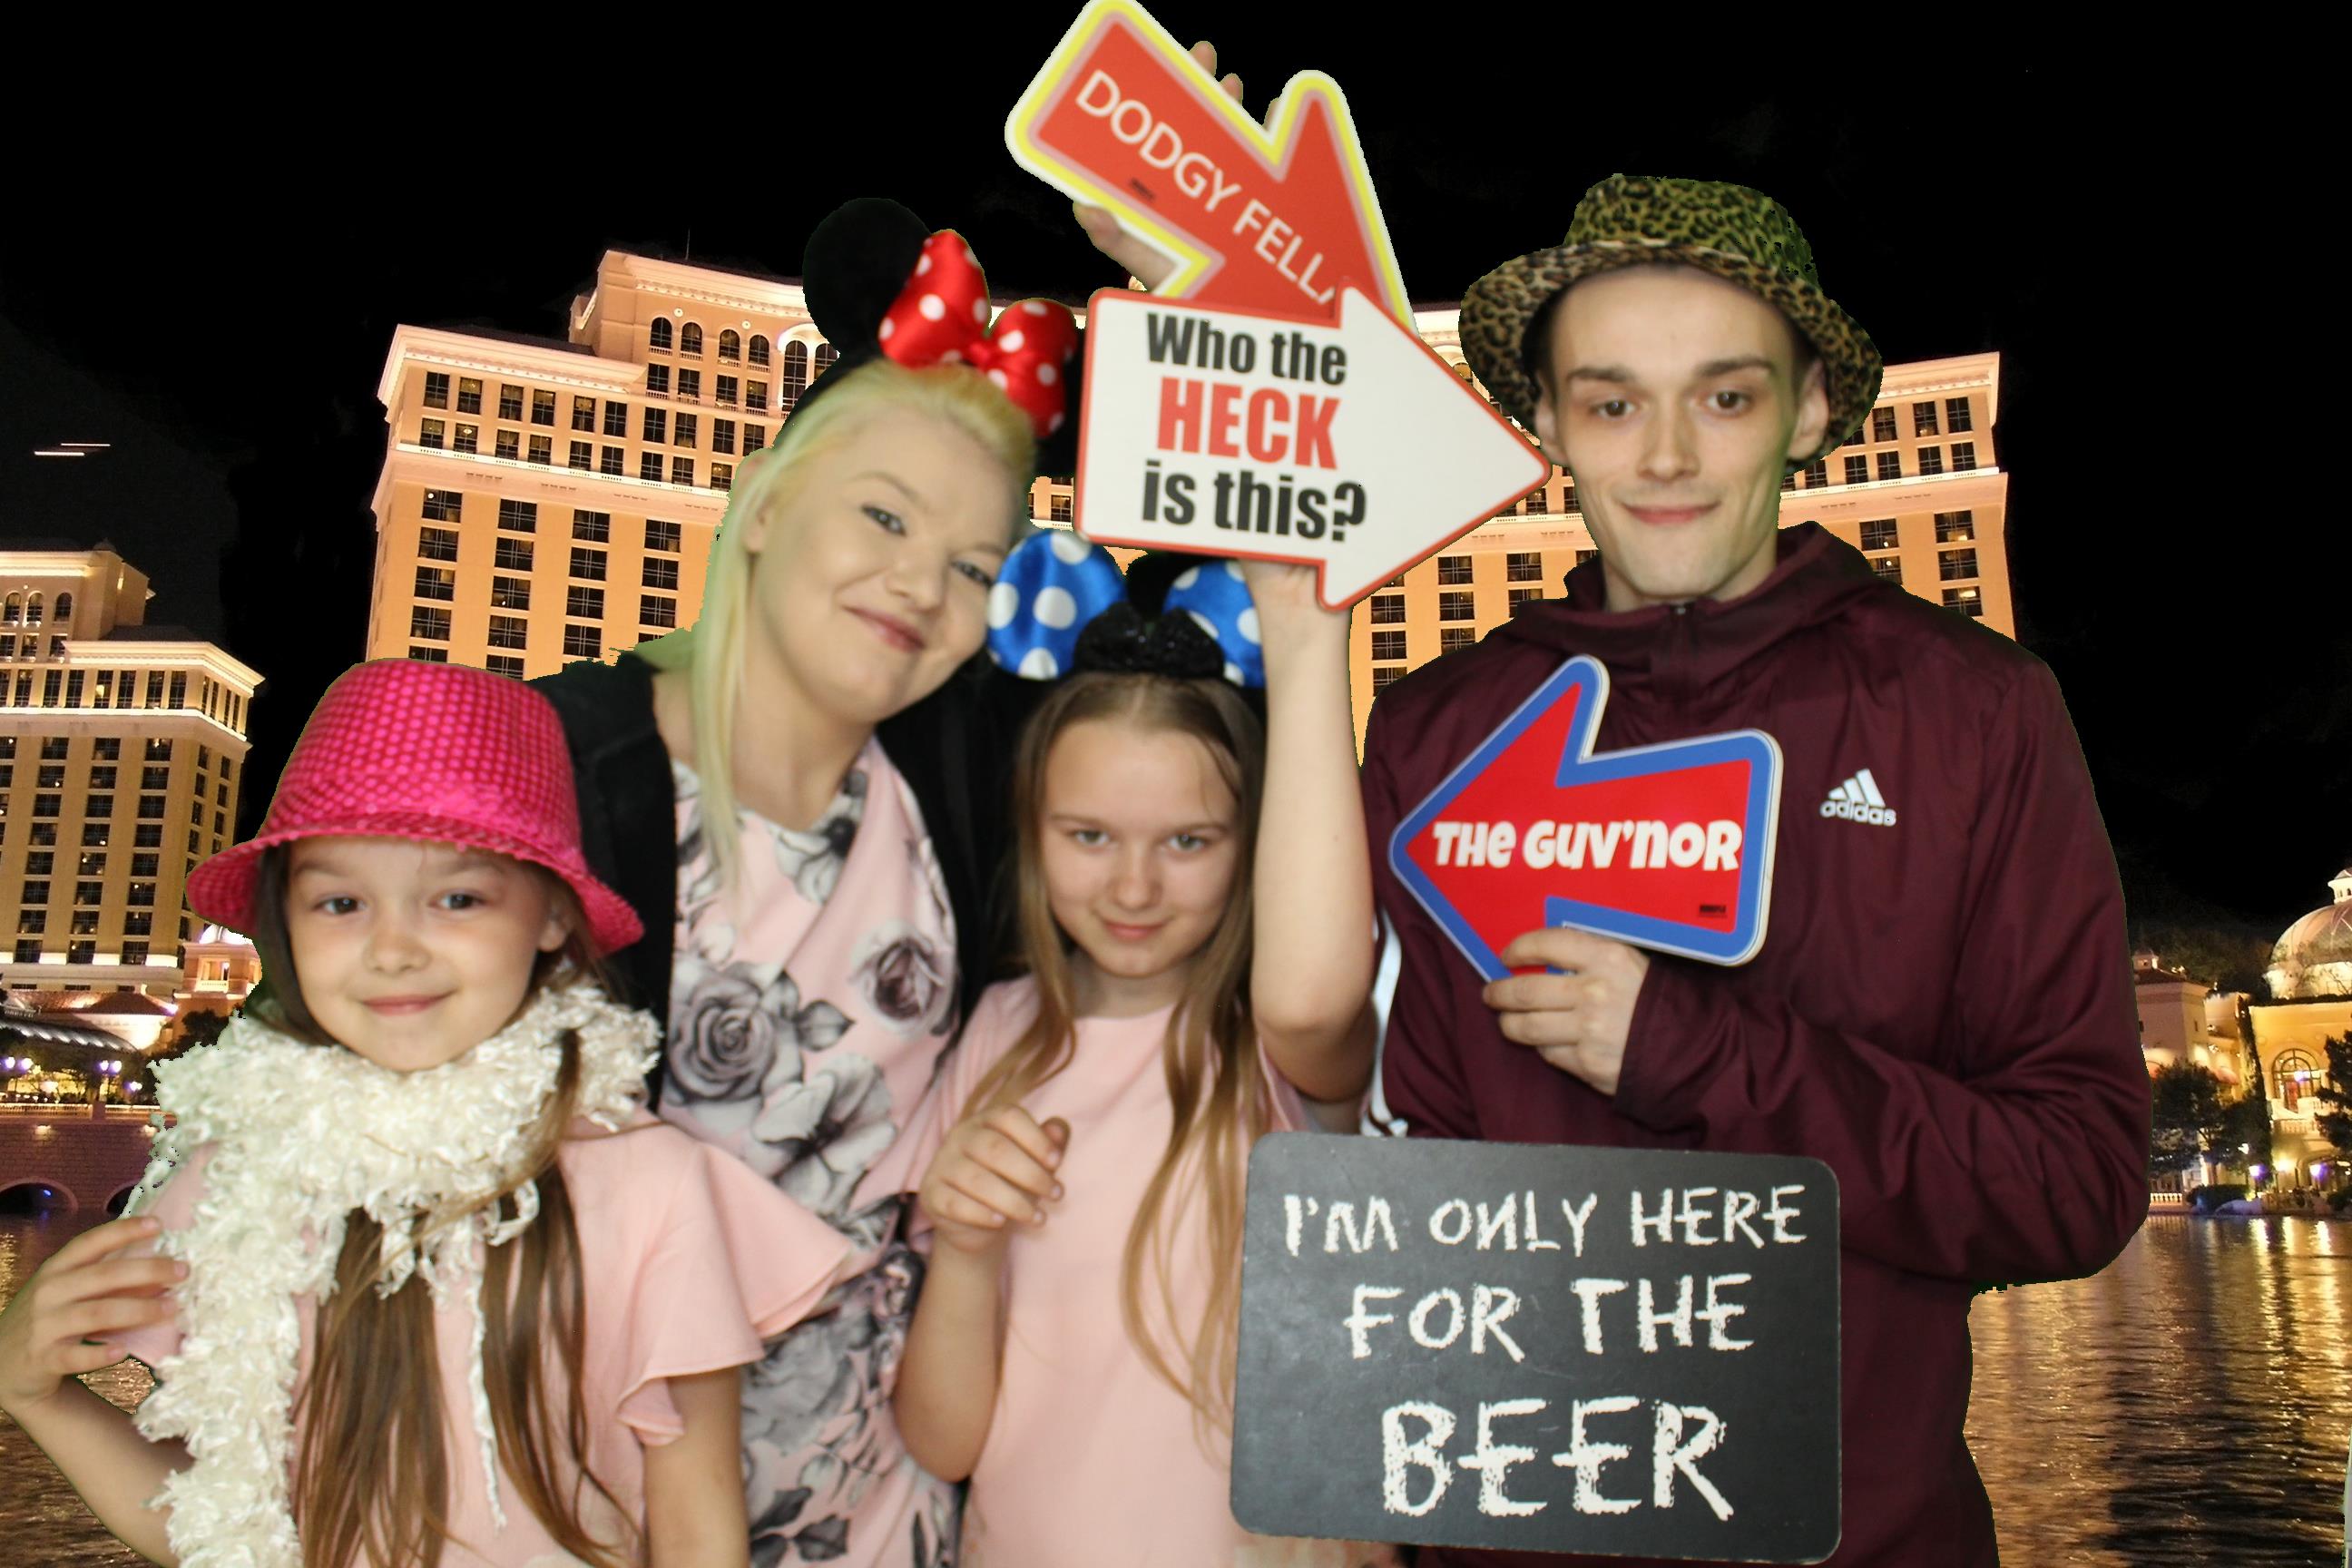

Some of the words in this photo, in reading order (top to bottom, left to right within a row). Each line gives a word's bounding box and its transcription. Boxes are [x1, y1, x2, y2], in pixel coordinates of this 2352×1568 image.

[1075, 70, 1241, 212] DODGY
[1146, 313, 1256, 375] Who
[1270, 332, 1348, 386] the
[1156, 377, 1340, 470] HECK
[1141, 459, 1196, 525] is
[1213, 470, 1367, 543] this?
[1819, 799, 1896, 827] adidas
[1284, 1194, 1398, 1256] I'M
[1428, 1191, 1597, 1257] ONLY
[1632, 1185, 1808, 1249] HERE
[1343, 1284, 1524, 1361] FOR
[1570, 1273, 1754, 1355] THE
[1381, 1396, 1734, 1521] BEER
